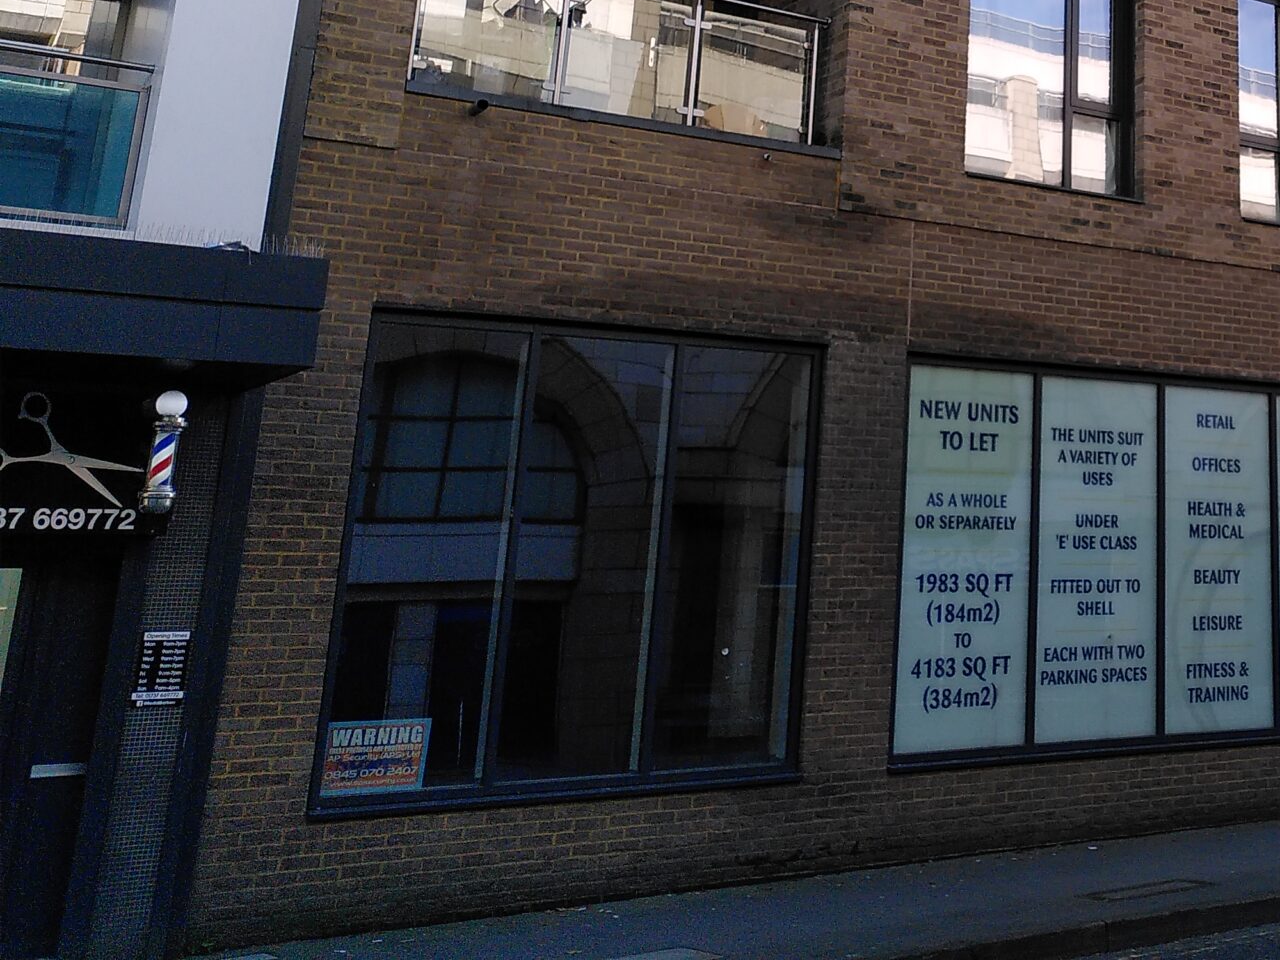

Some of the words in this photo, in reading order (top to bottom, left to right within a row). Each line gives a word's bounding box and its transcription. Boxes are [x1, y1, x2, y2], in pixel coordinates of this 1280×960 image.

[919, 400, 961, 421] NEW
[967, 403, 1019, 425] UNITS
[1196, 414, 1235, 429] RETAIL
[940, 430, 963, 450] TO
[969, 433, 999, 452] LET
[1051, 429, 1074, 442] THE
[1078, 429, 1114, 444] UNITS
[1118, 431, 1144, 446] SUIT
[1058, 450, 1068, 465] A
[1069, 450, 1118, 466] VARIETY
[1122, 453, 1137, 466] OF
[1192, 458, 1241, 474] OFFICES
[1082, 472, 1113, 486] USES
[927, 494, 944, 509] AS
[948, 494, 957, 508] A
[960, 493, 1007, 509] WHOLE
[1187, 502, 1232, 517] HEALTH
[1235, 502, 1245, 517] &
[33, 508, 136, 530] 669772
[915, 515, 936, 530] OR
[939, 515, 1016, 531] SEPARATELY
[1076, 515, 1118, 528] UNDER
[1189, 524, 1244, 539] MEDICAL
[1056, 536, 1069, 549] 'E'
[1072, 536, 1098, 550] USE
[1102, 536, 1137, 550] CLASS
[1194, 569, 1240, 585] BEAUTY
[916, 574, 959, 594] 1983
[965, 574, 990, 598] SQ
[995, 574, 1013, 592] FT
[1051, 580, 1092, 594] FITTED
[1096, 579, 1121, 593] OUT
[1125, 578, 1140, 593] TO
[926, 599, 1000, 626] (184m2)
[1077, 601, 1115, 616] SHELL
[1192, 616, 1242, 631] LEISURE
[954, 632, 971, 649] TO
[1044, 648, 1077, 663] EACH
[1082, 647, 1114, 661] WITH
[1118, 645, 1145, 660] TWO
[911, 658, 956, 678] 4183
[962, 658, 987, 681] SQ
[991, 657, 1010, 675] FT
[1040, 669, 1097, 685] PARKING
[1102, 667, 1147, 683] SPACES
[1186, 663, 1235, 679] FITNESS
[1239, 663, 1249, 677] &
[923, 683, 997, 713] (384m2)
[1187, 686, 1248, 703] TRAINING
[333, 726, 423, 747] WARNING
[343, 753, 379, 761] Security
[360, 768, 384, 777] 070
[387, 766, 418, 775] 2407
